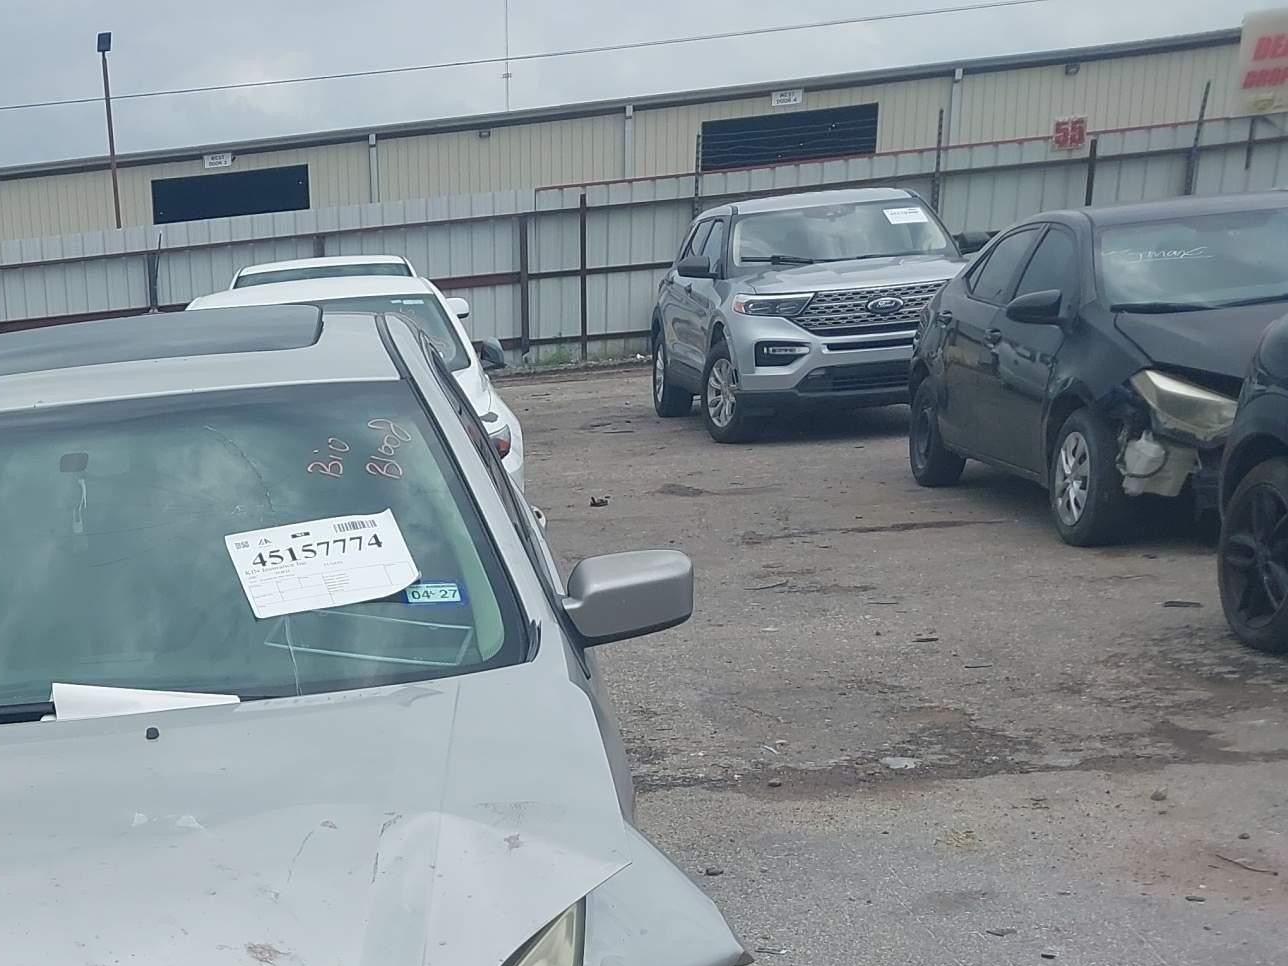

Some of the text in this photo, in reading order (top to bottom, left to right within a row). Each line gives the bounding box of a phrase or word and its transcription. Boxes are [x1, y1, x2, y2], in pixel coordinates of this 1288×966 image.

[252, 533, 383, 567] 45157774
[412, 589, 457, 599] 04 27
